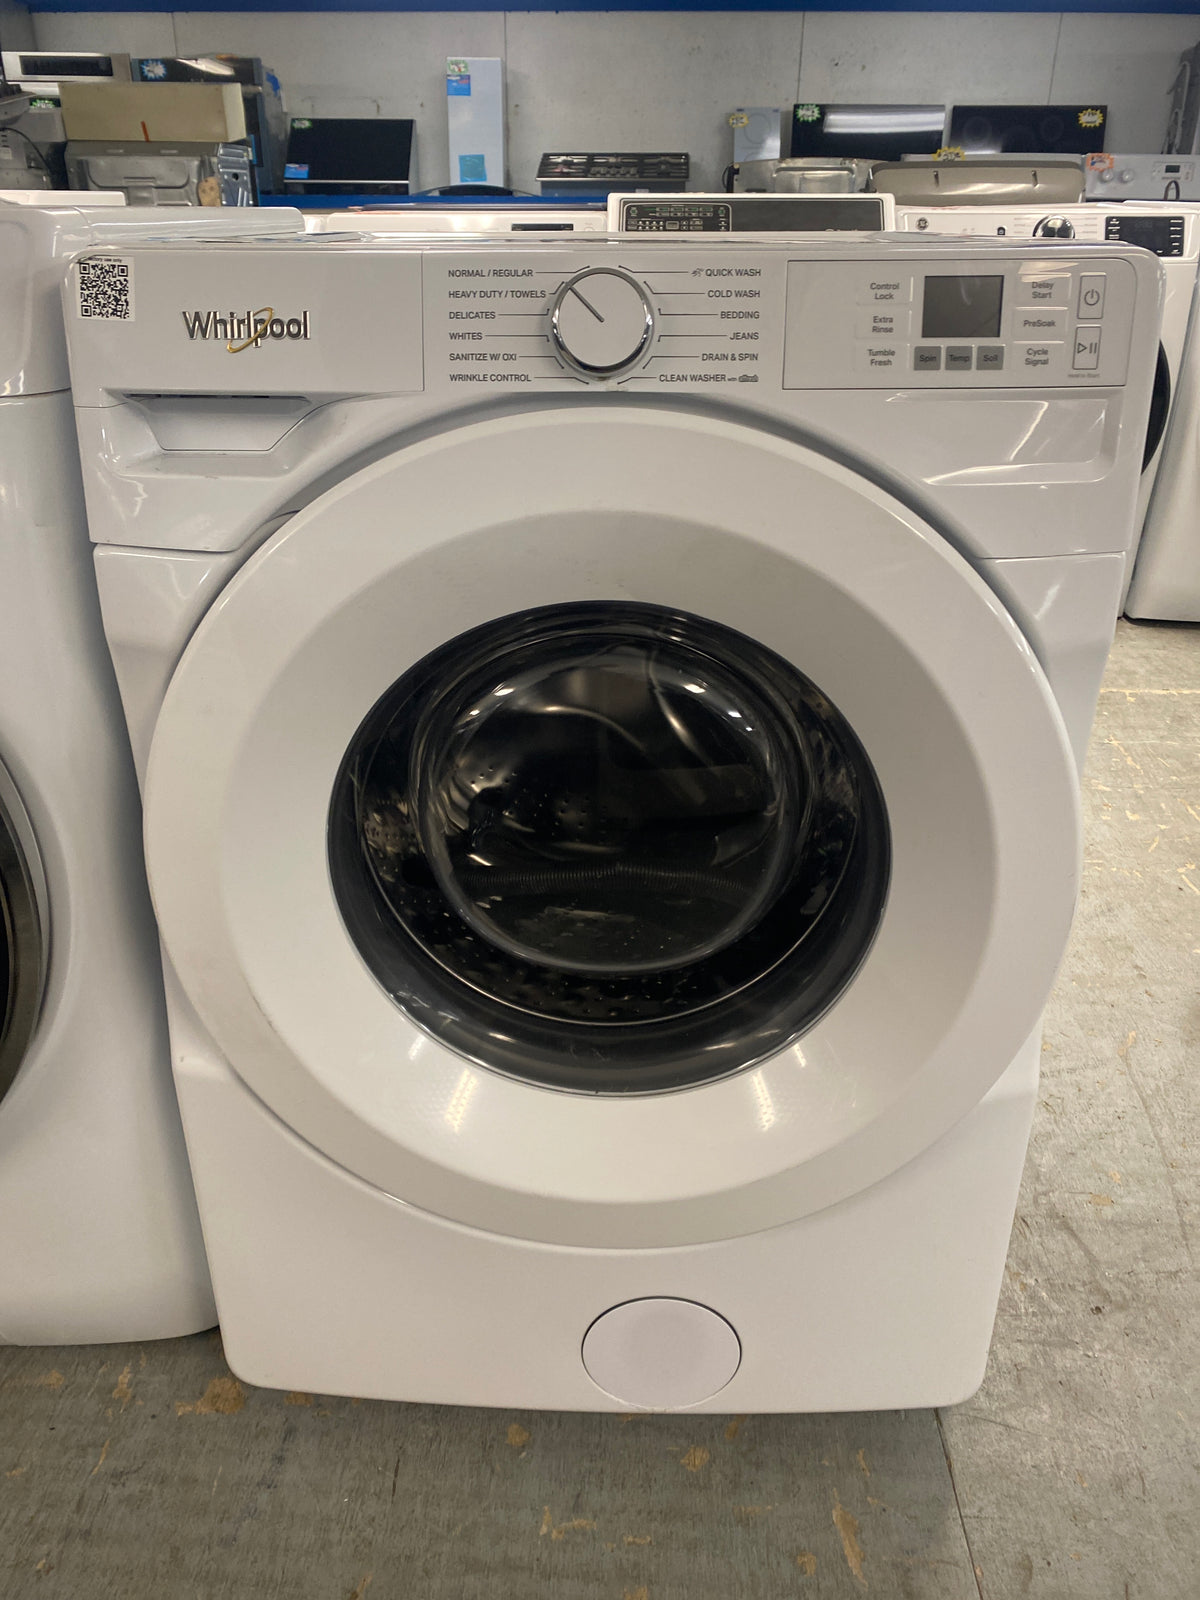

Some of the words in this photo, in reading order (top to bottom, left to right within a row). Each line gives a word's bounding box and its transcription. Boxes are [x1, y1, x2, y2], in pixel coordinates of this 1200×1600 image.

[448, 269, 486, 278] NORMAL
[487, 269, 491, 278] /
[492, 269, 534, 278] REGULAR
[705, 268, 734, 277] QUICK
[735, 268, 762, 277] WASH
[869, 282, 900, 292] Control
[1031, 281, 1054, 291] Delay
[448, 290, 478, 299] HEAVY
[479, 290, 504, 299] DUTY
[504, 290, 508, 299] /
[510, 289, 547, 299] TOWELS
[707, 290, 733, 298] COLD
[734, 290, 761, 298] WASH
[874, 292, 895, 301] Lock
[1031, 291, 1053, 300] Start
[448, 311, 496, 320] DELICATES
[720, 311, 760, 319] BEDDING
[872, 316, 894, 325] Extra
[1023, 319, 1057, 328] PreSoak
[182, 310, 310, 348] Whirlpool
[871, 325, 894, 334] Rinse
[449, 332, 483, 340] WHITES
[729, 332, 760, 340] JEANS
[449, 353, 488, 361] SANITIZE
[489, 353, 500, 361] W/
[502, 353, 518, 361] OXI
[701, 353, 729, 361] DRAIN
[730, 353, 737, 361] &
[738, 353, 759, 361] SPIN
[867, 348, 897, 358] Tumble
[1026, 347, 1050, 358] Cycle
[870, 358, 893, 367] Fresh
[919, 354, 937, 364] Spin
[949, 354, 971, 364] Temp
[983, 354, 999, 363] Soil
[1024, 357, 1050, 368] Signal
[449, 374, 488, 382] WRINKLE
[490, 374, 532, 382] CONTROL
[659, 374, 688, 382] CLEAN
[689, 374, 726, 382] WASHER
